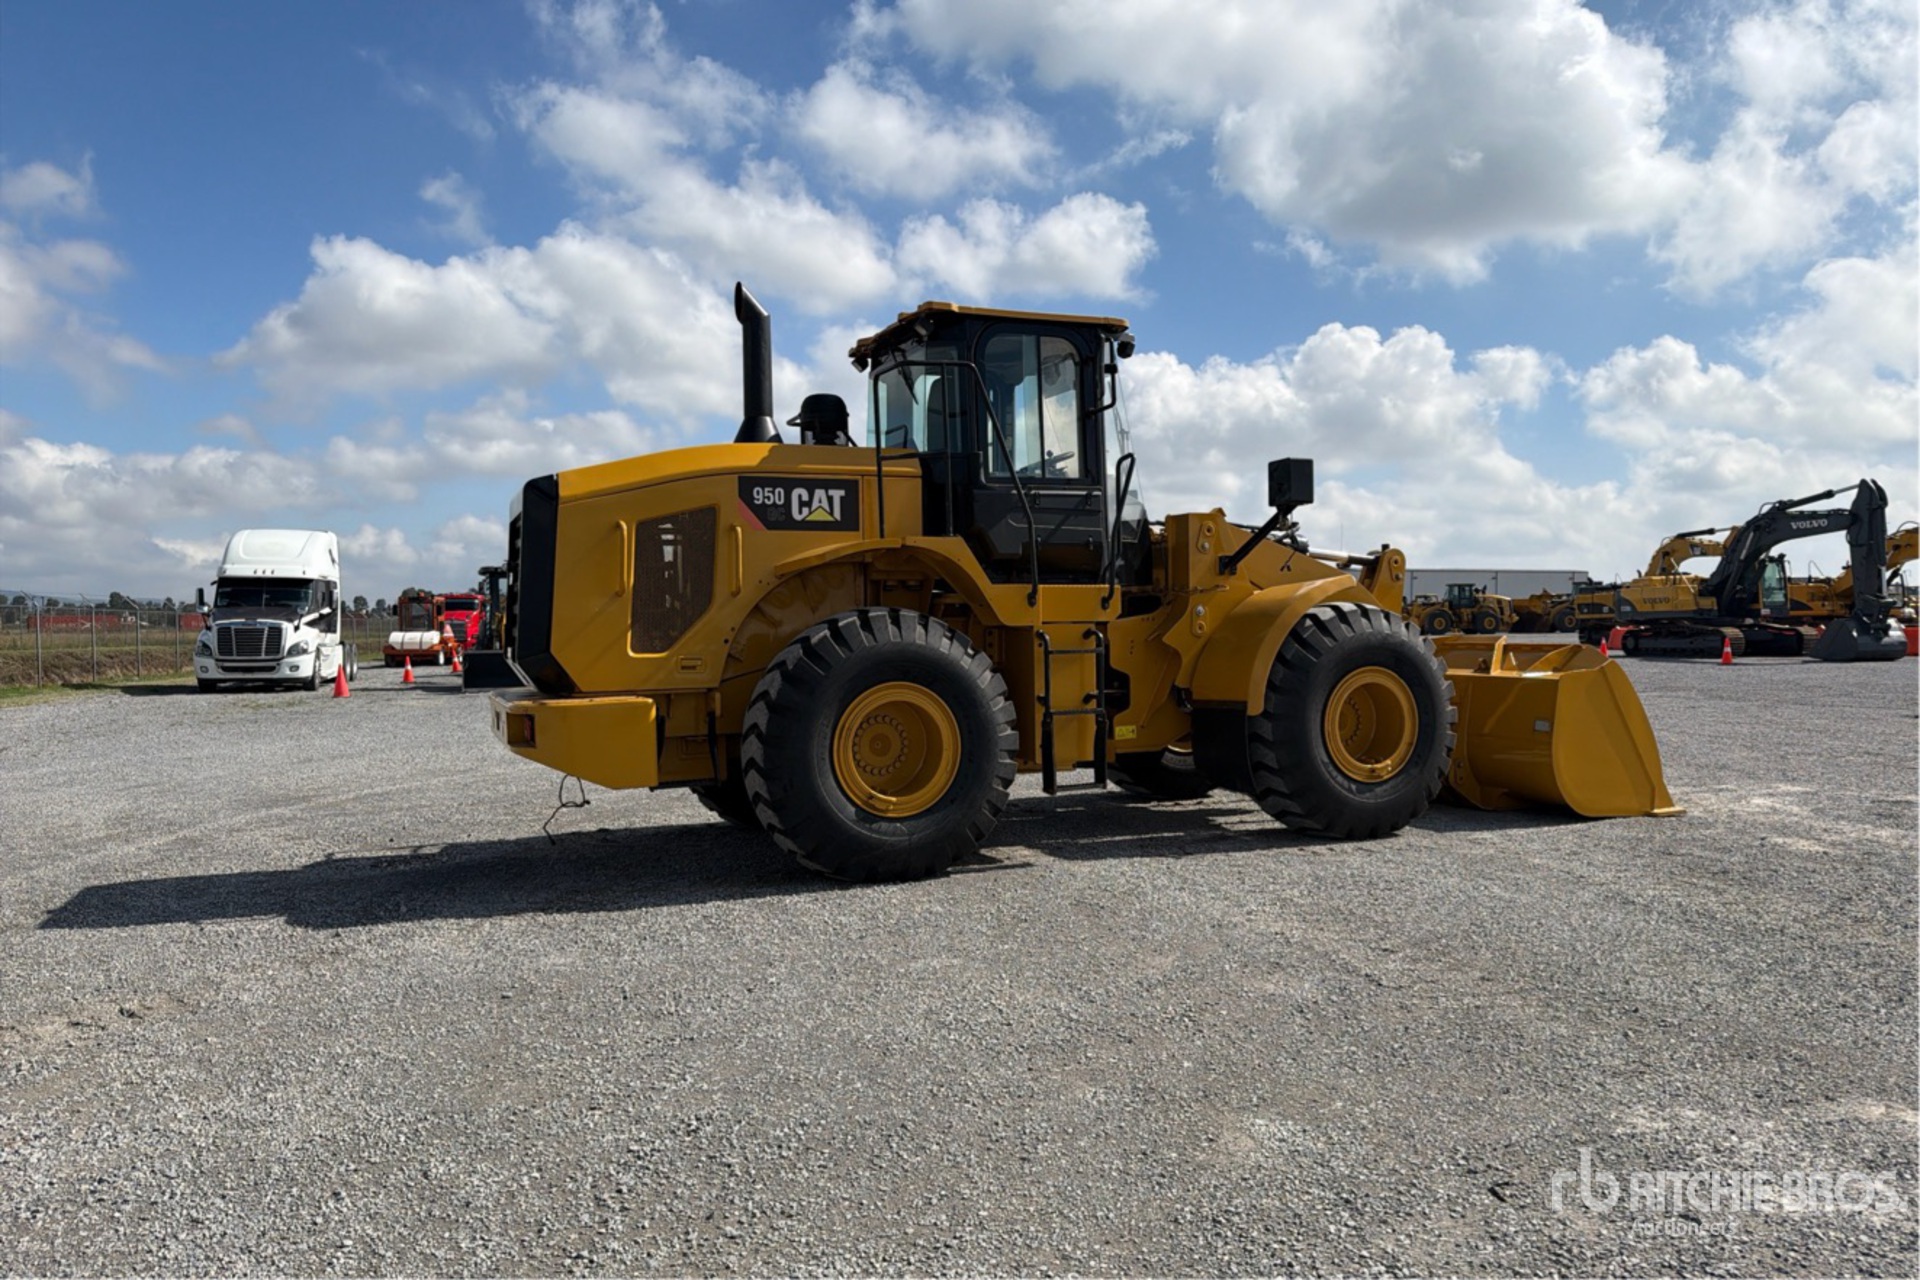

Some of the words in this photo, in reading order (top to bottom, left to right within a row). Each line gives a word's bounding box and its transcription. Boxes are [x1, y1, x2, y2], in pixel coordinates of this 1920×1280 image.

[753, 487, 785, 505] 950
[791, 487, 846, 522] CAT
[1791, 519, 1828, 529] VOLVO
